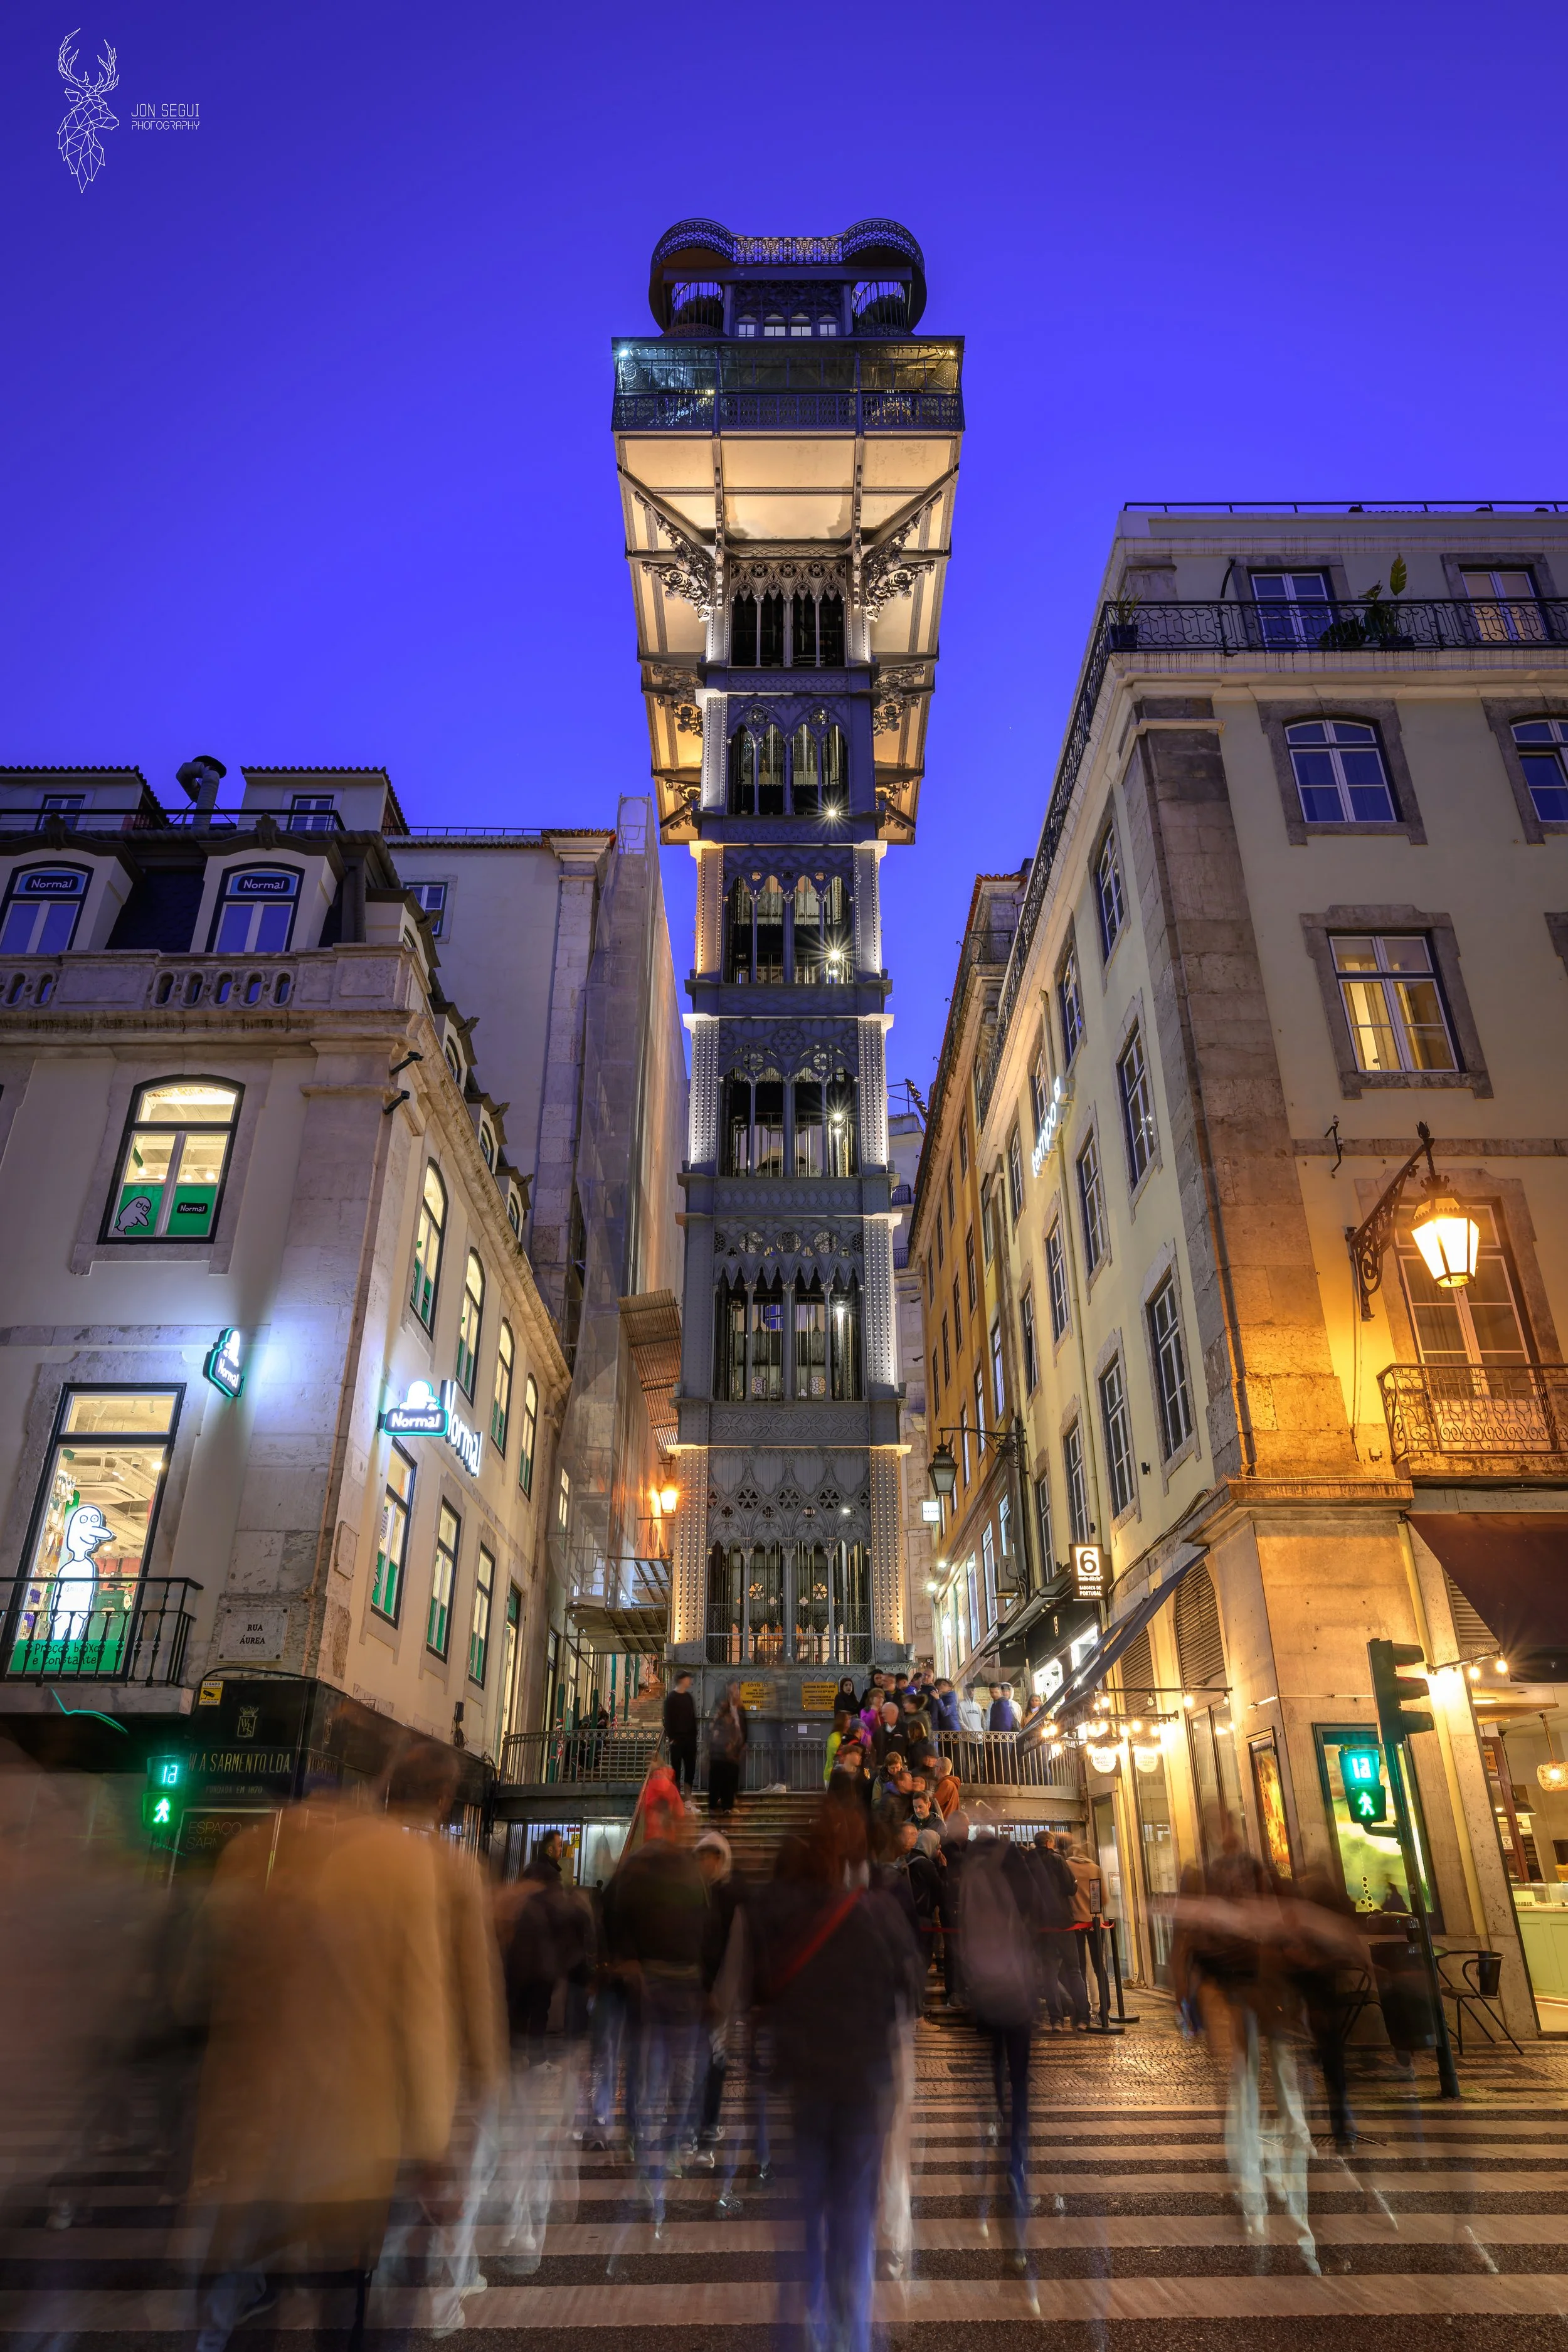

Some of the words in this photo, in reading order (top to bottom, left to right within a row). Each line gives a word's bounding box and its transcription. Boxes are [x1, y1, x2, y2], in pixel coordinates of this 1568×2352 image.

[31, 878, 73, 888] Normal
[243, 879, 284, 889] Normal
[1032, 1101, 1056, 1178] tempo
[218, 1358, 239, 1388] Normal
[391, 1412, 441, 1428] Normal
[1080, 1550, 1096, 1573] 6
[240, 1634, 265, 1644] ÁUREA
[236, 1786, 245, 1794] EM
[248, 1786, 263, 1794] 1870
[189, 1821, 242, 1836] ESPAÇO
